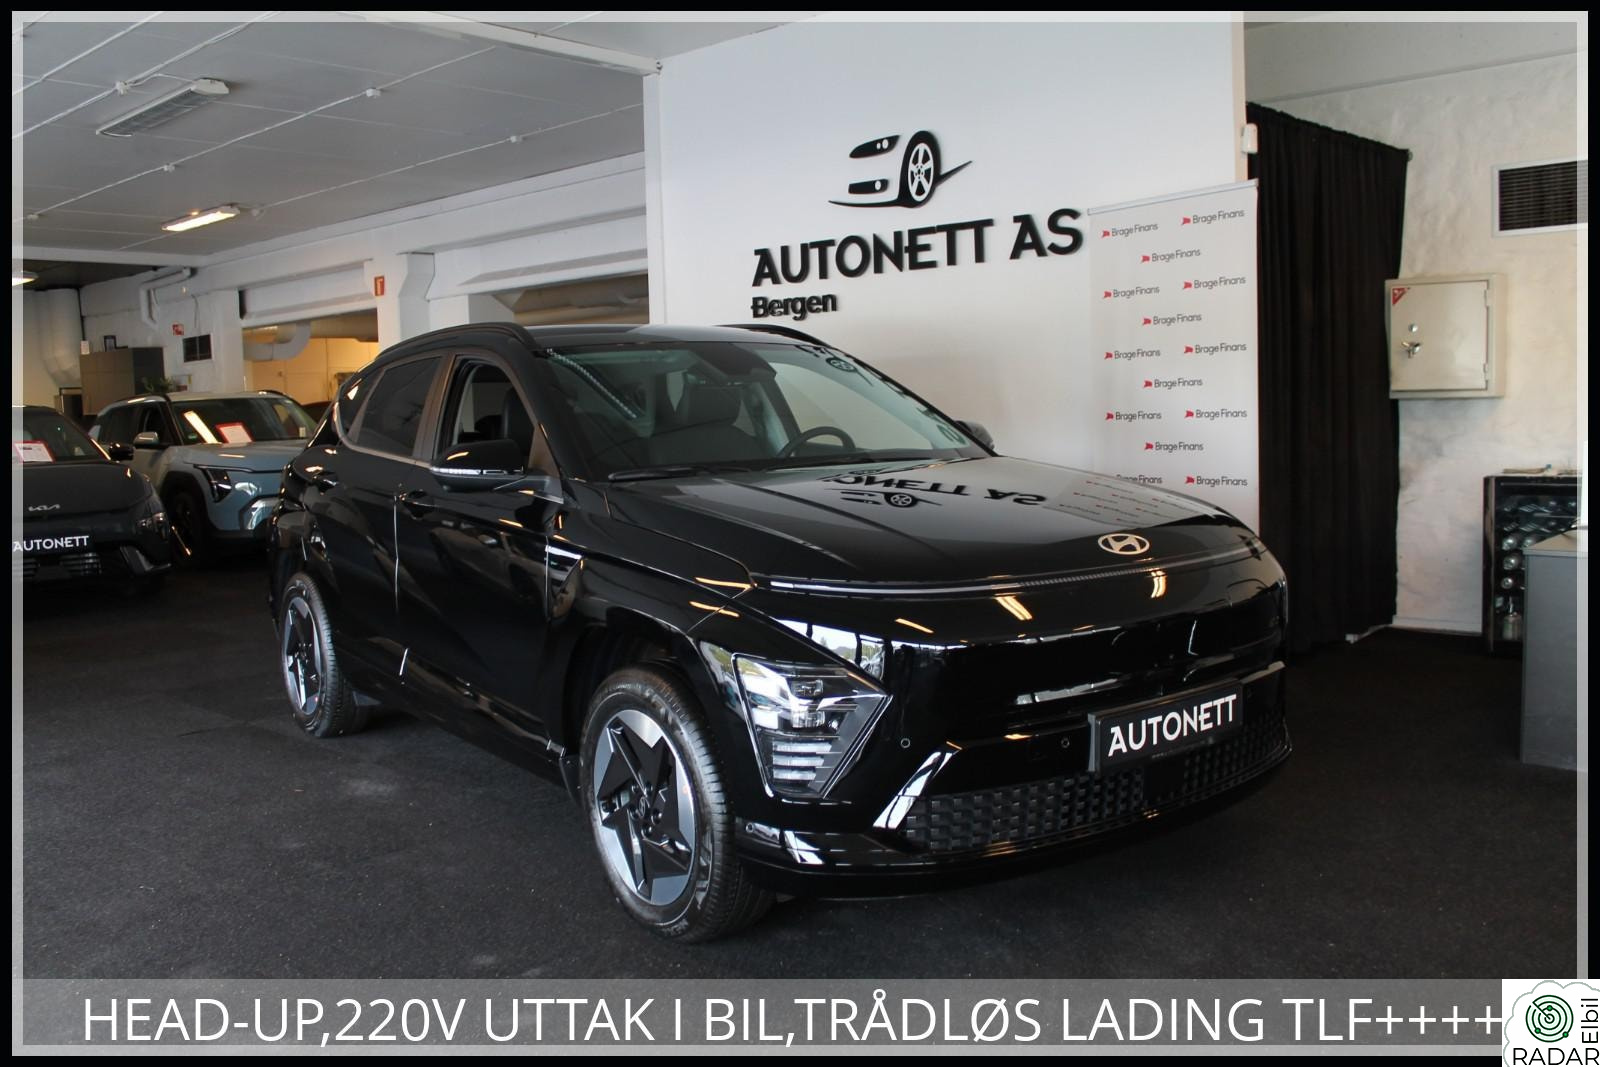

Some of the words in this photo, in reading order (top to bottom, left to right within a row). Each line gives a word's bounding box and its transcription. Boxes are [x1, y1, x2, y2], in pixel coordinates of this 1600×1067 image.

[1193, 213, 1217, 225] Brage
[1217, 209, 1245, 220] Finans
[1111, 227, 1134, 238] Brage
[1134, 222, 1158, 233] Finans
[752, 218, 994, 287] AUTONETT
[1009, 208, 1084, 260] AS
[1151, 252, 1175, 263] Brage
[1175, 248, 1201, 259] Finans
[1194, 279, 1218, 290] Brage
[1218, 275, 1246, 286] Finans
[1112, 289, 1135, 299] Brage
[1135, 284, 1160, 295] Finans
[751, 293, 838, 321] Bergen
[1153, 316, 1176, 327] Brage
[1176, 312, 1202, 323] Finans
[1114, 350, 1136, 361] Brage
[1136, 348, 1161, 358] Finans
[1195, 344, 1219, 356] Brage
[1219, 342, 1247, 352] Finans
[1154, 379, 1177, 390] Brage
[1177, 377, 1203, 387] Finans
[1115, 412, 1137, 422] Brage
[1137, 410, 1162, 420] Finans
[1195, 409, 1220, 421] Brage
[1220, 407, 1248, 418] Finans
[1155, 441, 1178, 453] Brage
[1178, 441, 1204, 451] Finans
[1196, 475, 1221, 488] Brage
[1221, 476, 1248, 487] Finans
[13, 535, 90, 552] AUTONETT
[1108, 693, 1238, 757] AUTONETT
